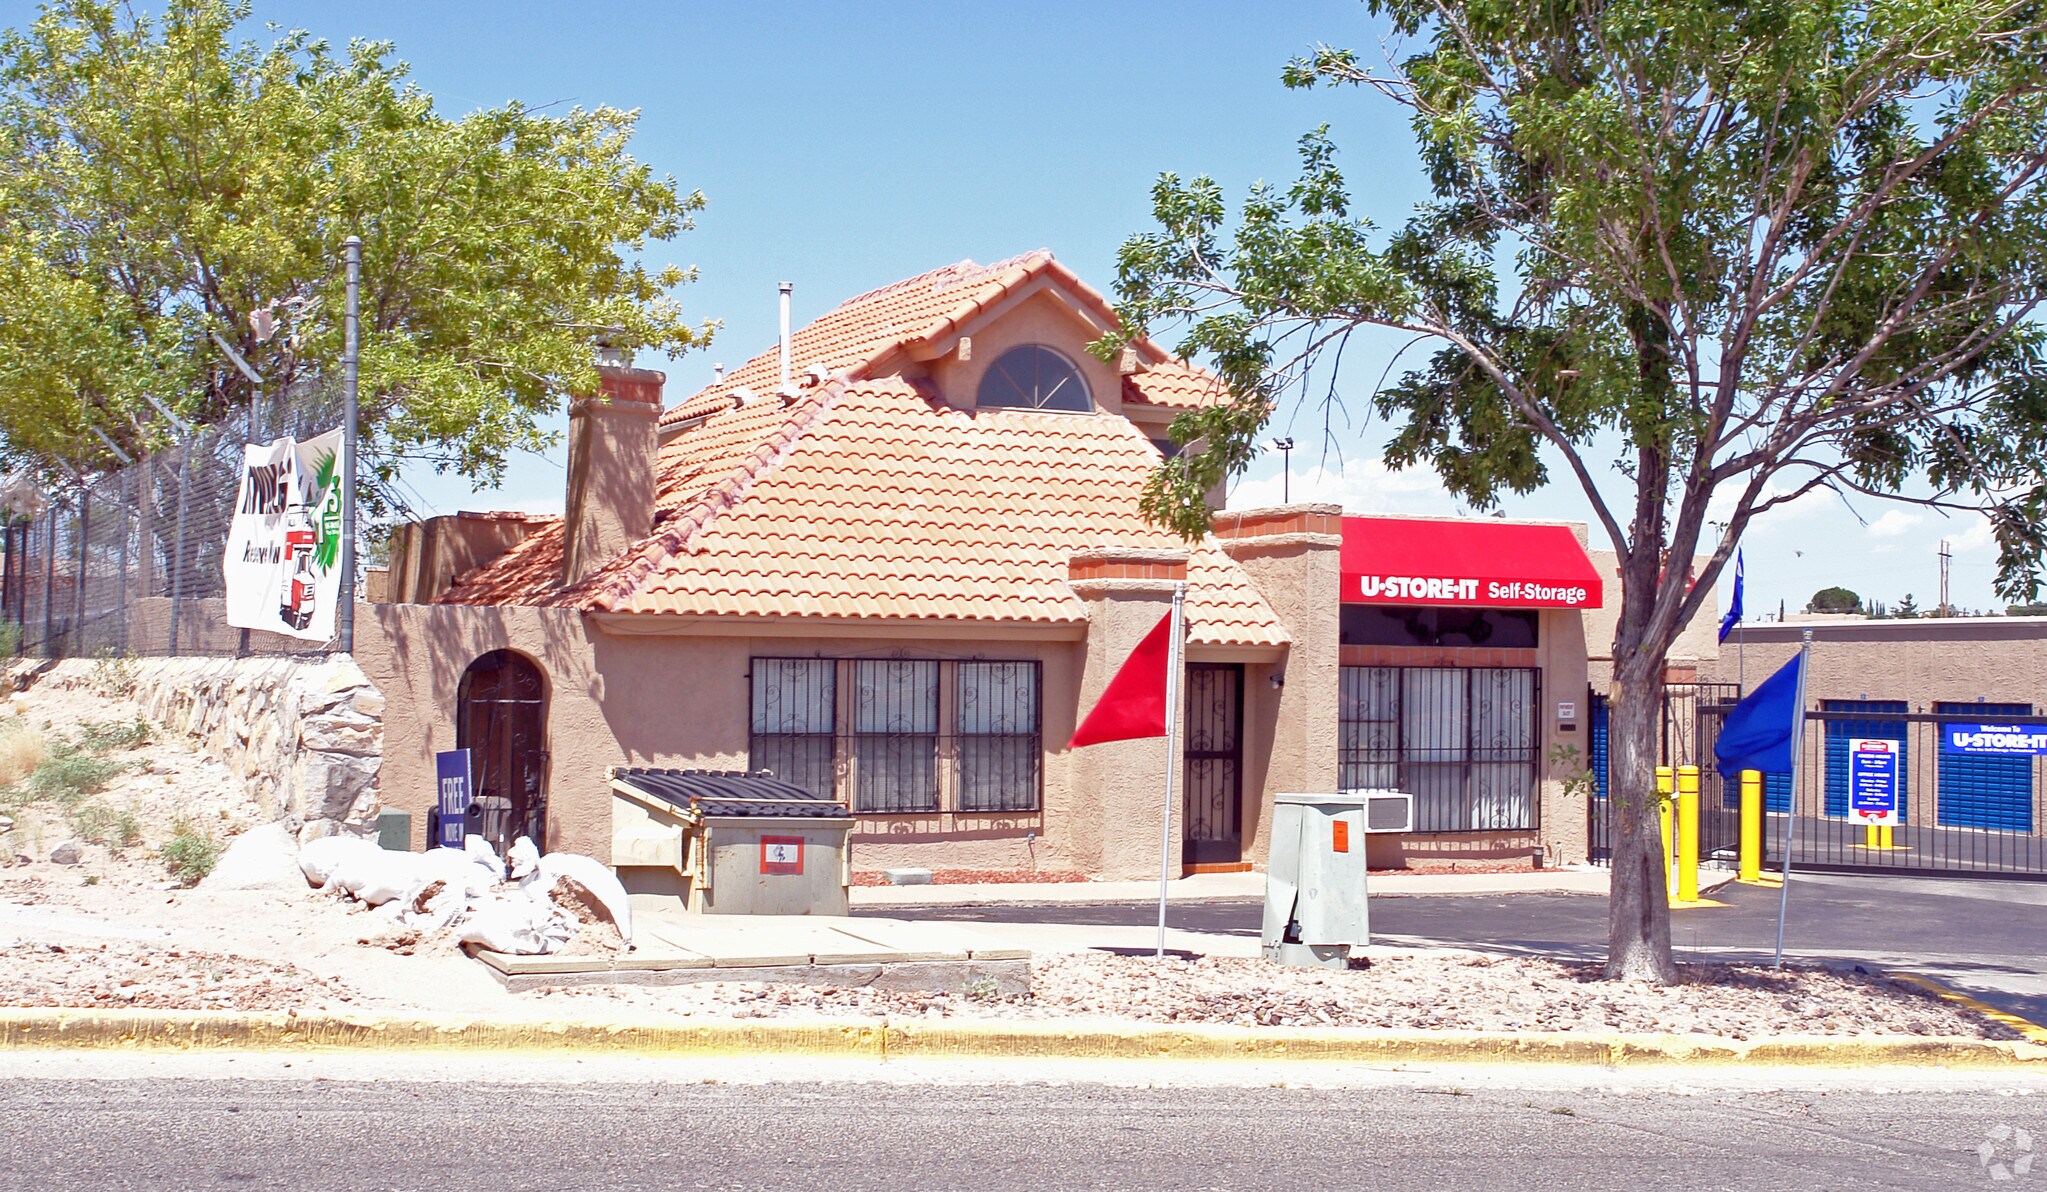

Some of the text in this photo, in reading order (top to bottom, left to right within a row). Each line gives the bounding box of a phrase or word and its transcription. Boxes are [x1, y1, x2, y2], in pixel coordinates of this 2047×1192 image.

[1488, 581, 1587, 604] Self-Storage
[1980, 725, 2021, 733] Welcome To
[442, 777, 465, 815] FREE
